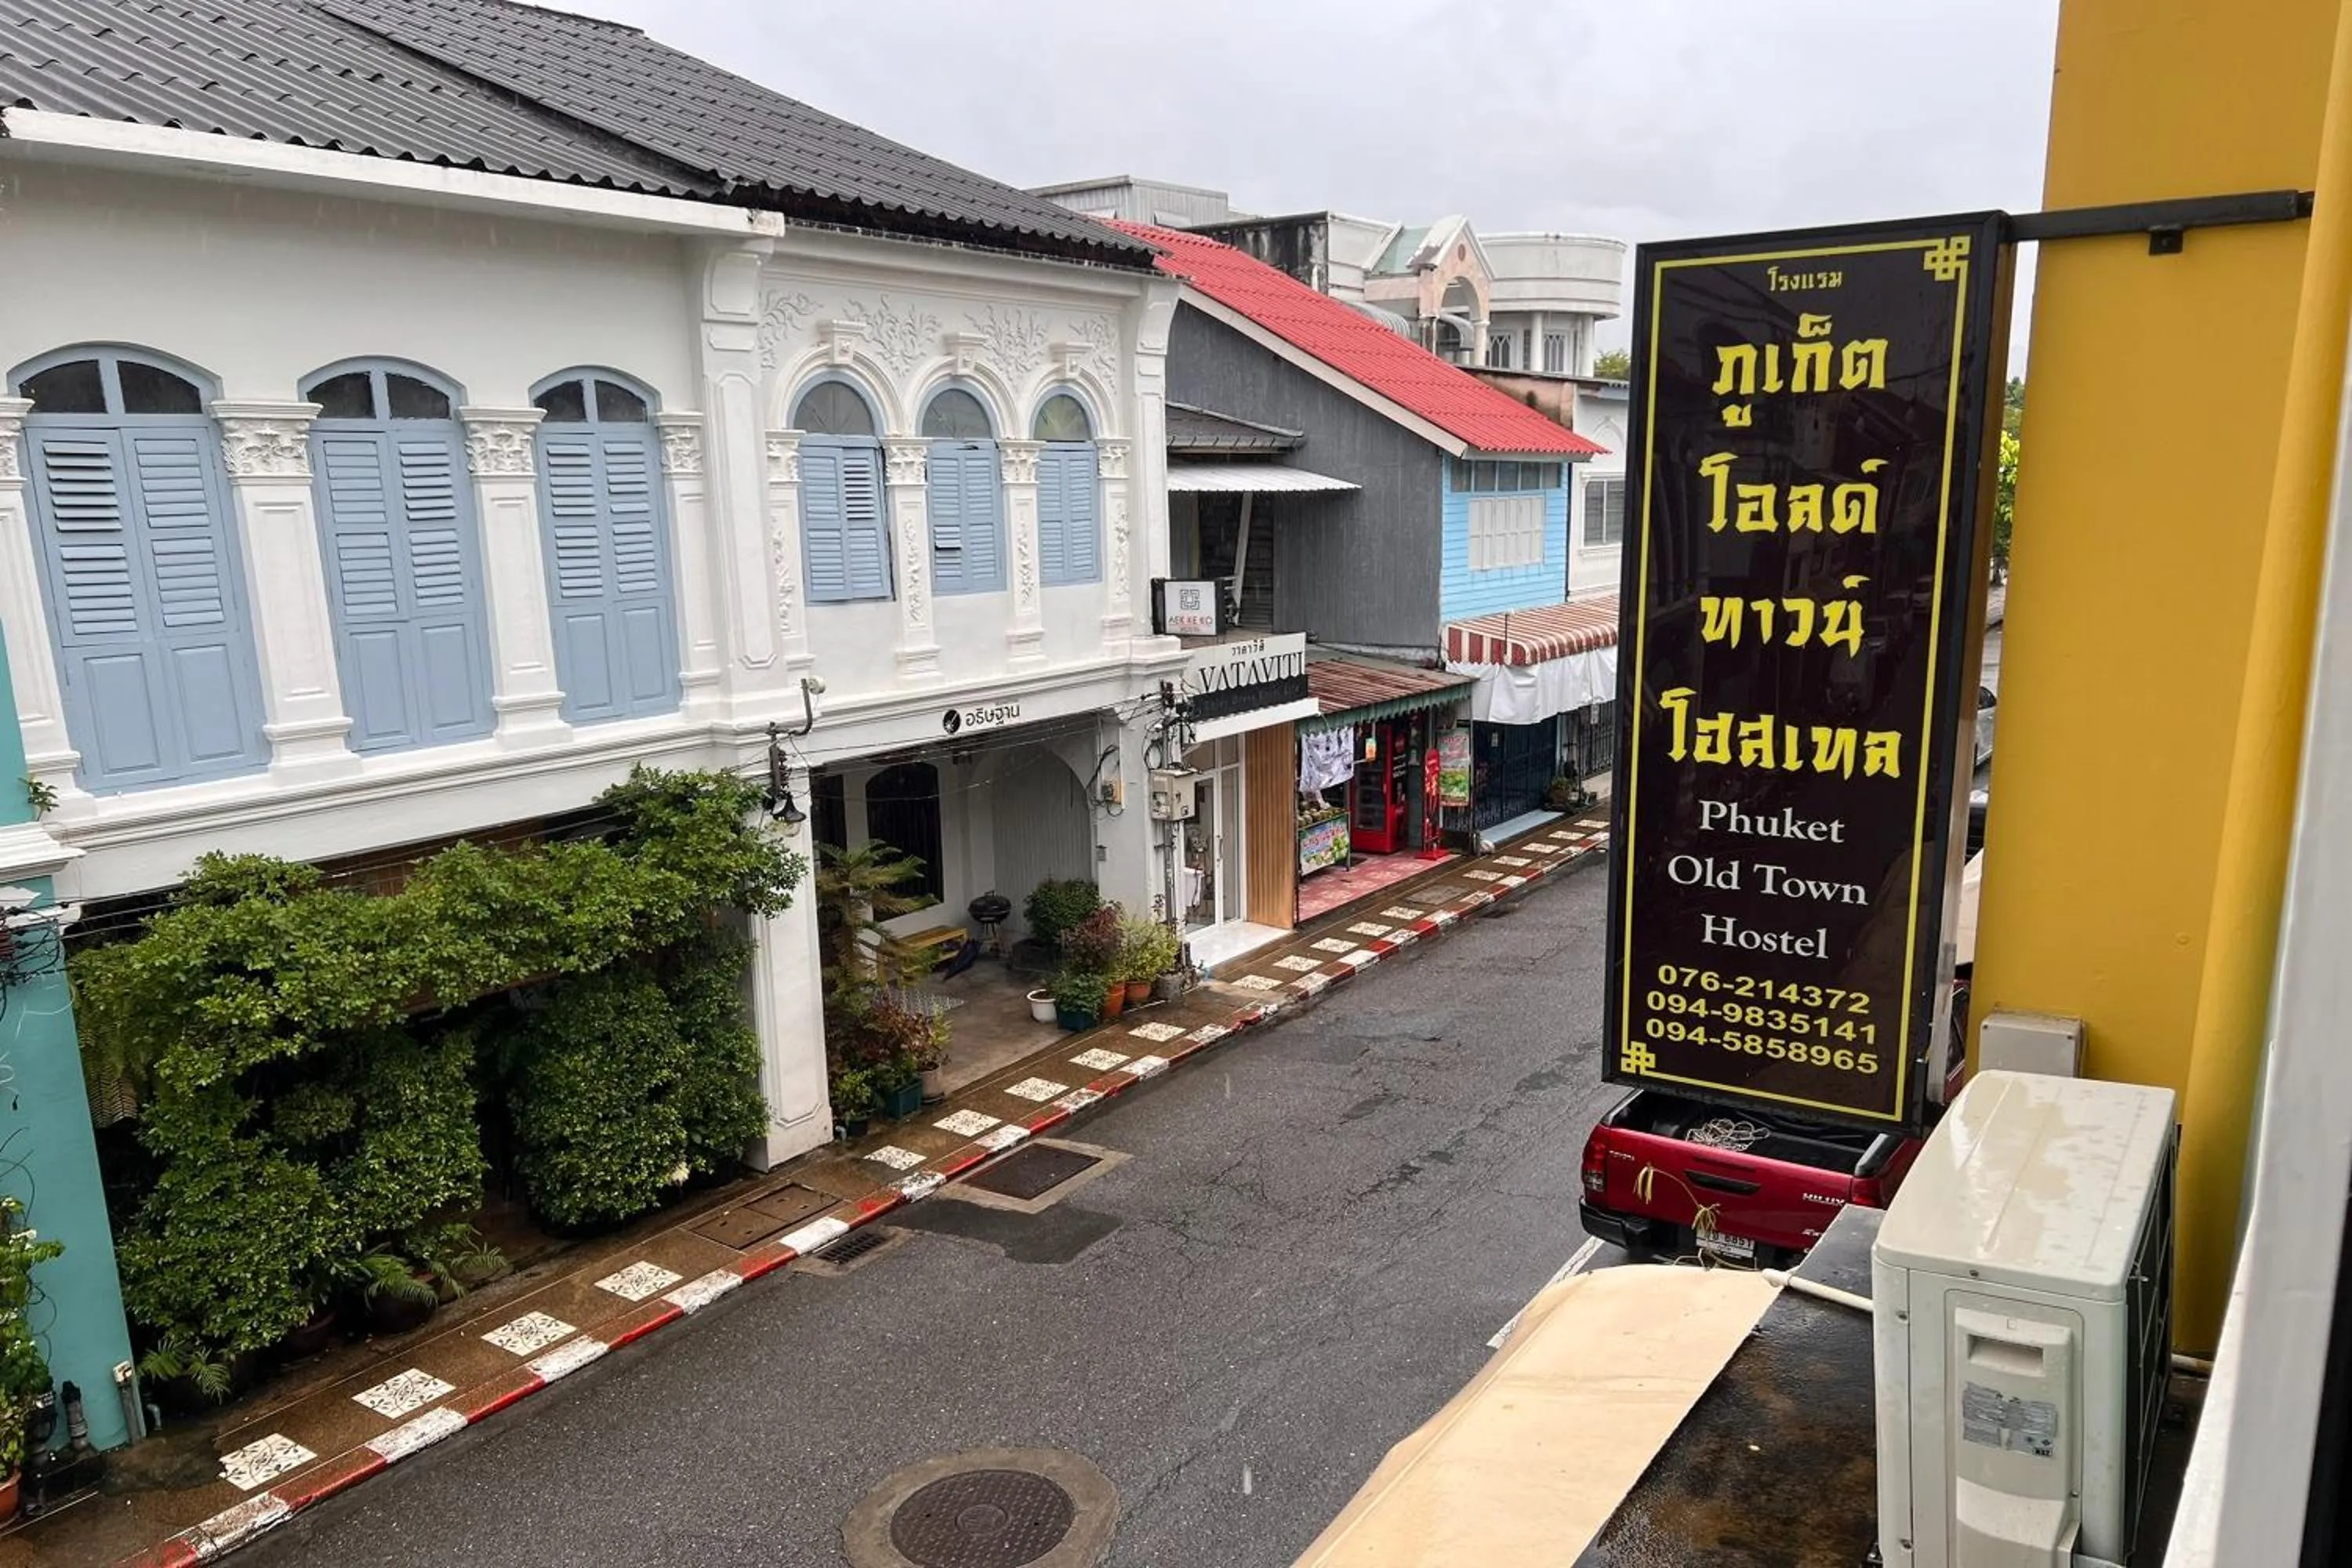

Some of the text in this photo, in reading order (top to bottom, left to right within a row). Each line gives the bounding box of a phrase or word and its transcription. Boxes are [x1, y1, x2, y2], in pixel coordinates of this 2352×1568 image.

[1768, 267, 1842, 291] โรงแรม
[1712, 314, 1888, 426] ภูเก็ต
[1699, 452, 1886, 533] โอลด์
[1701, 575, 1869, 657] ทาวน์
[1199, 652, 1303, 694] VATAVITI
[1660, 688, 1901, 779] โฮสเทล
[1700, 800, 1844, 842] Phuket
[1668, 856, 1867, 905] Old Town
[1702, 914, 1828, 958] Hostel
[1657, 964, 1871, 1014] 076-214372
[1646, 989, 1876, 1045] 094-9835141
[1646, 1018, 1878, 1074] 094-5858965
